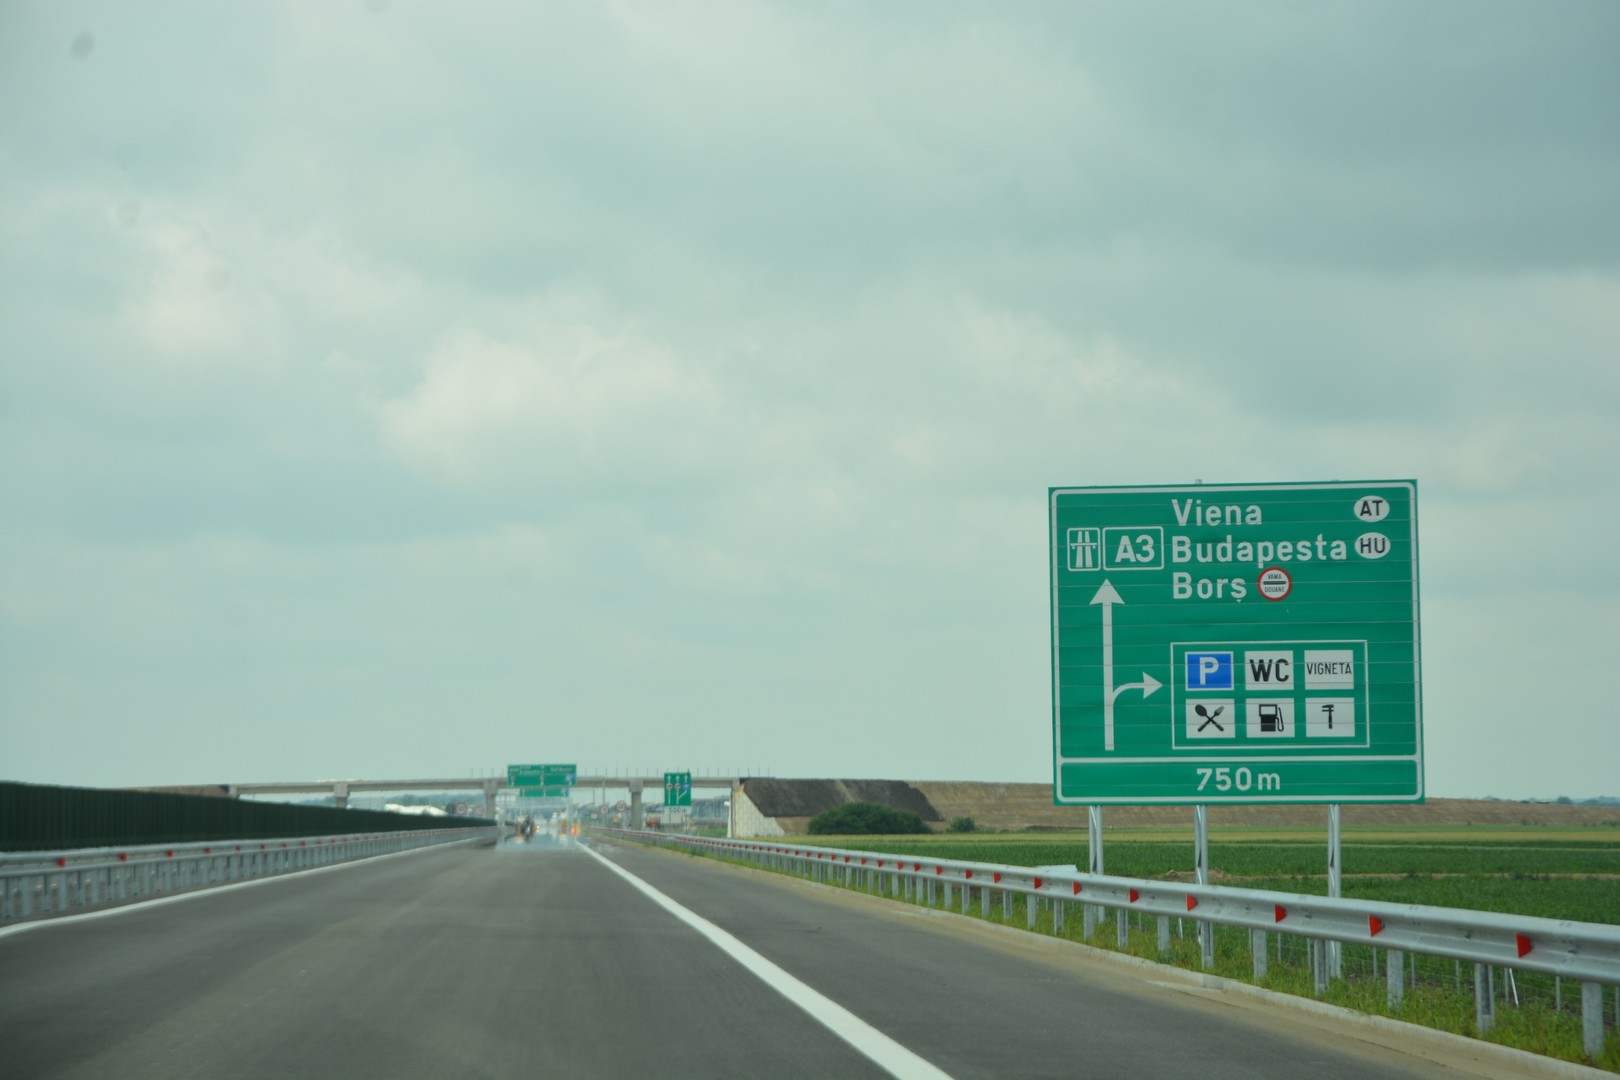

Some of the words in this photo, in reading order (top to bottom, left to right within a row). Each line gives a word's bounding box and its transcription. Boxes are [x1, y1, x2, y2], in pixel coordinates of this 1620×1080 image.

[1171, 499, 1262, 527] Viena
[1359, 500, 1383, 517] AT
[1115, 534, 1155, 563] A3
[1172, 533, 1347, 568] Budapesta
[1359, 537, 1386, 554] HU
[1173, 572, 1247, 602] Borș
[1199, 656, 1219, 685] P
[1250, 658, 1290, 683] WC
[1306, 662, 1352, 675] VIGNETA
